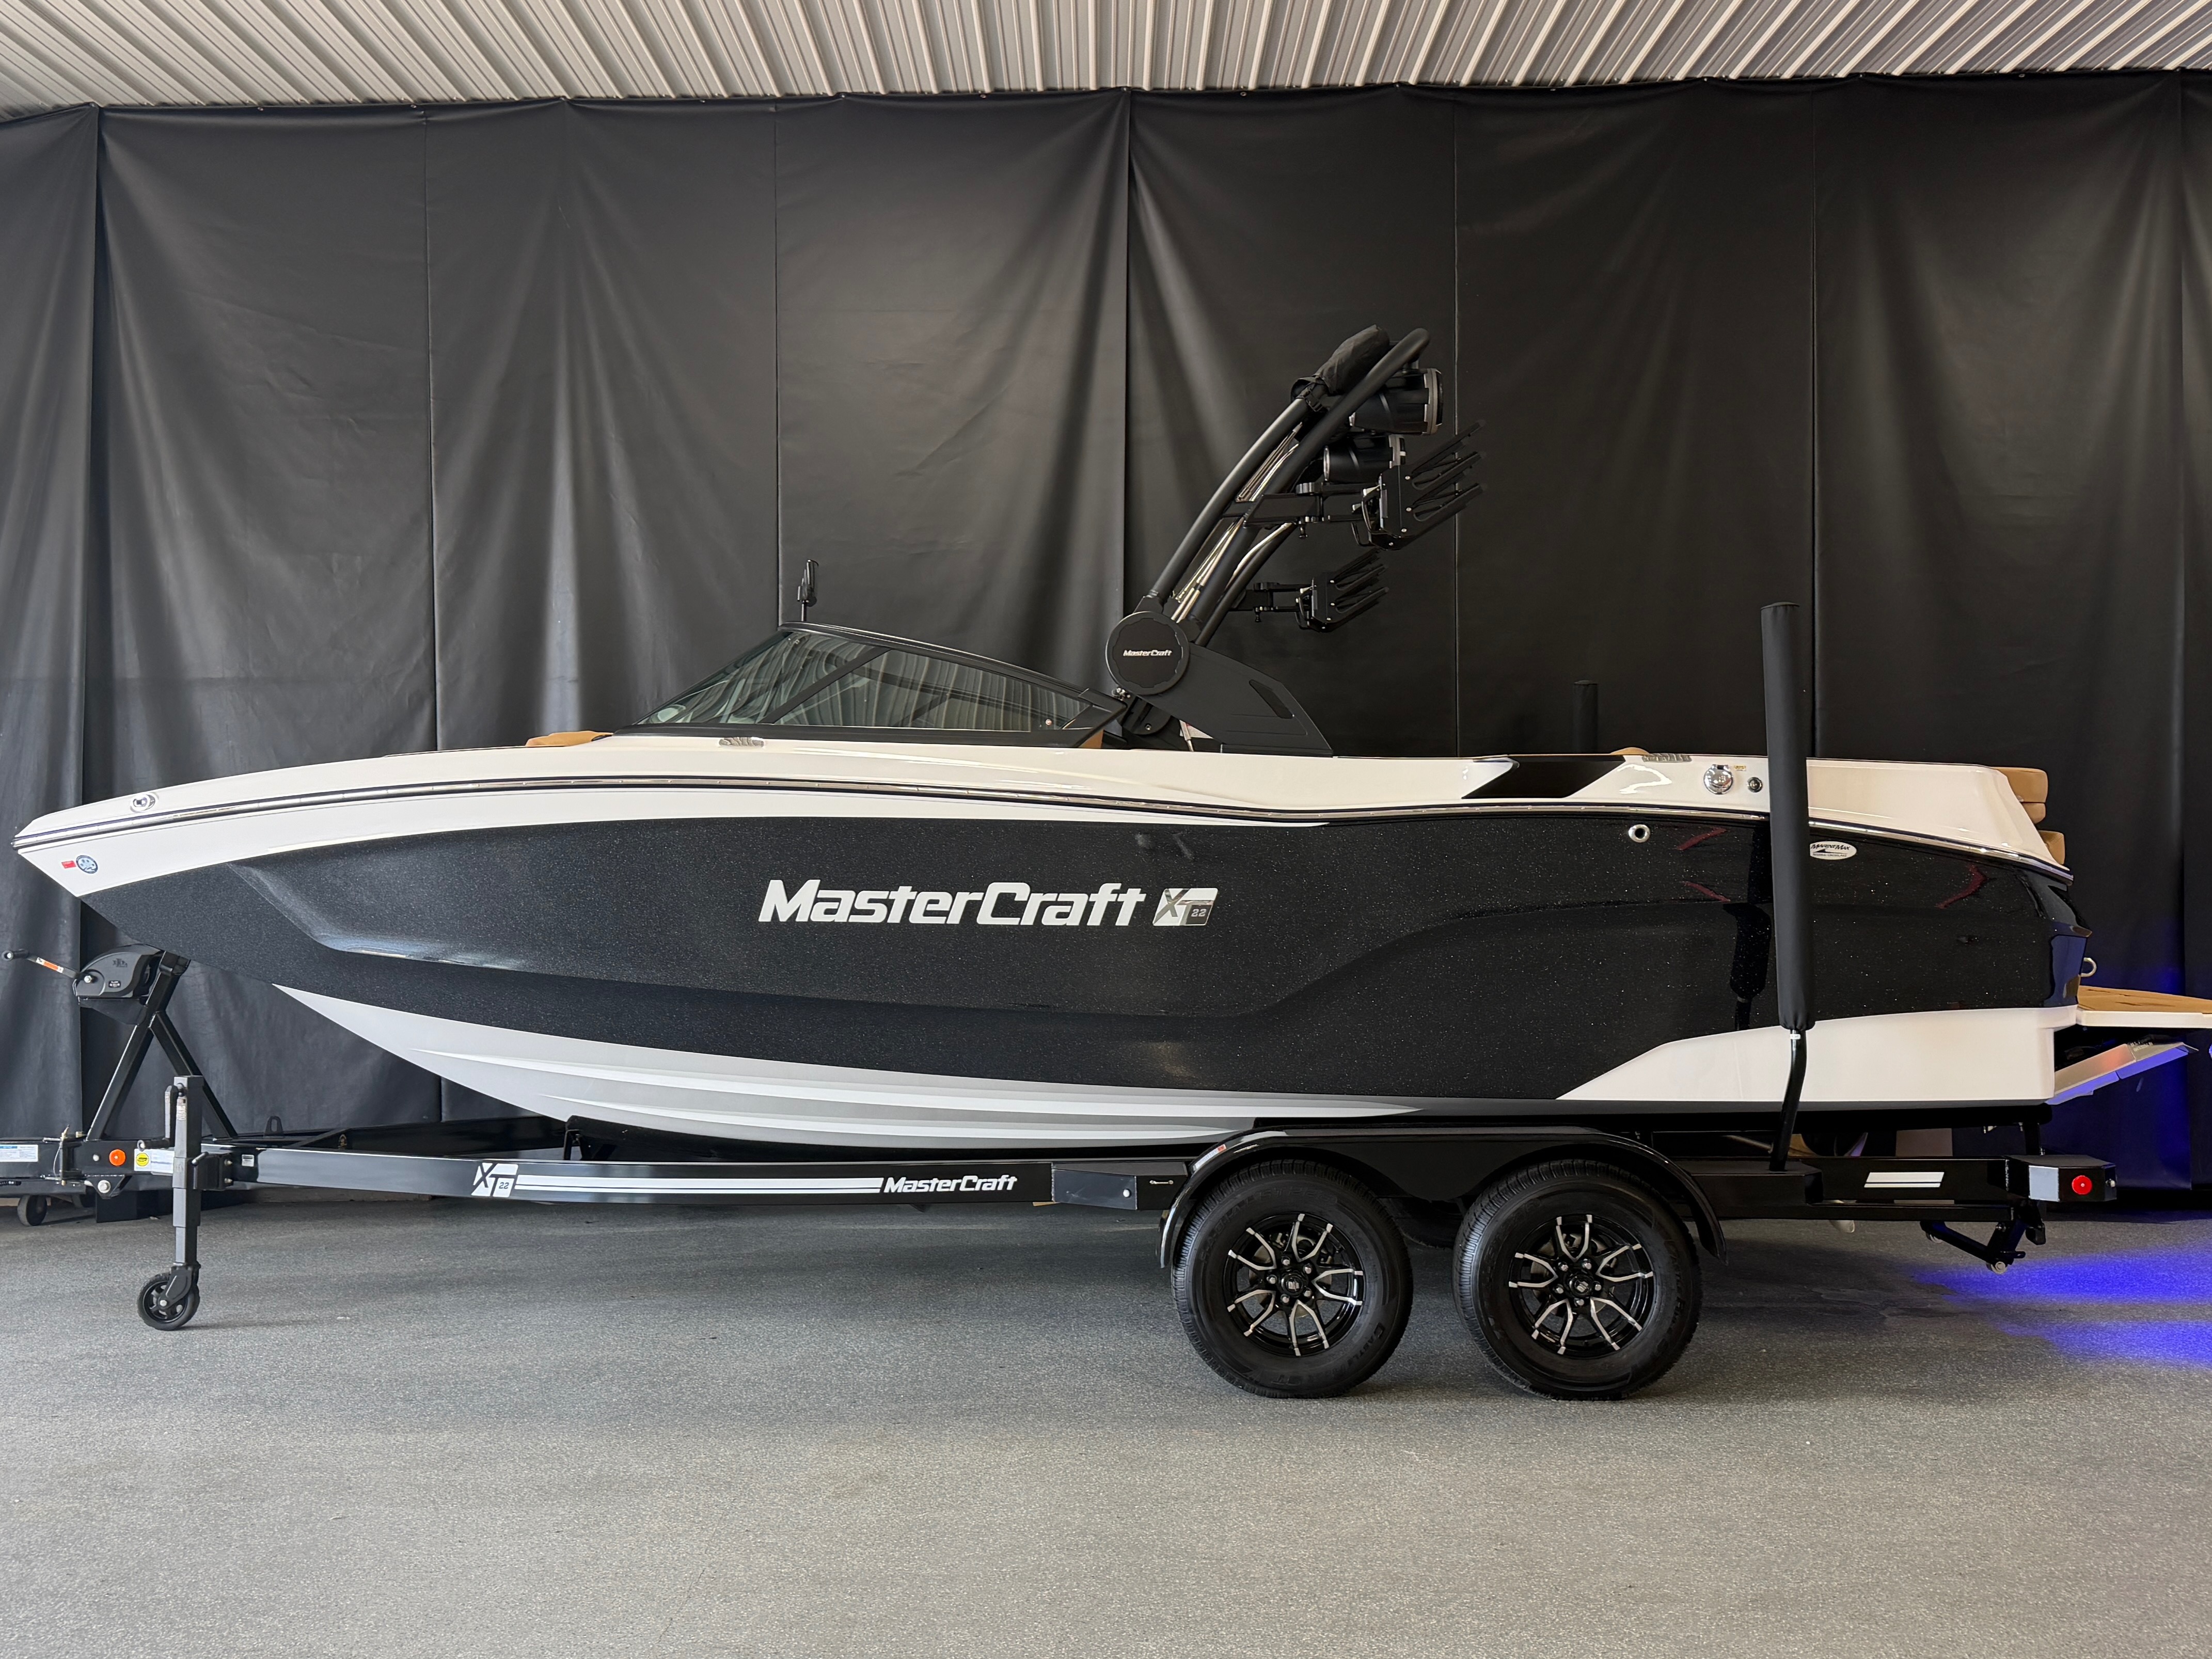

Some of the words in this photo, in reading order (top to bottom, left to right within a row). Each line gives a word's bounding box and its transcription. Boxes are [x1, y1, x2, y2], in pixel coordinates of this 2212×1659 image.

[758, 879, 1147, 926] MasterCraft
[1191, 908, 1207, 917] 22
[883, 1174, 1018, 1194] MasterCraft
